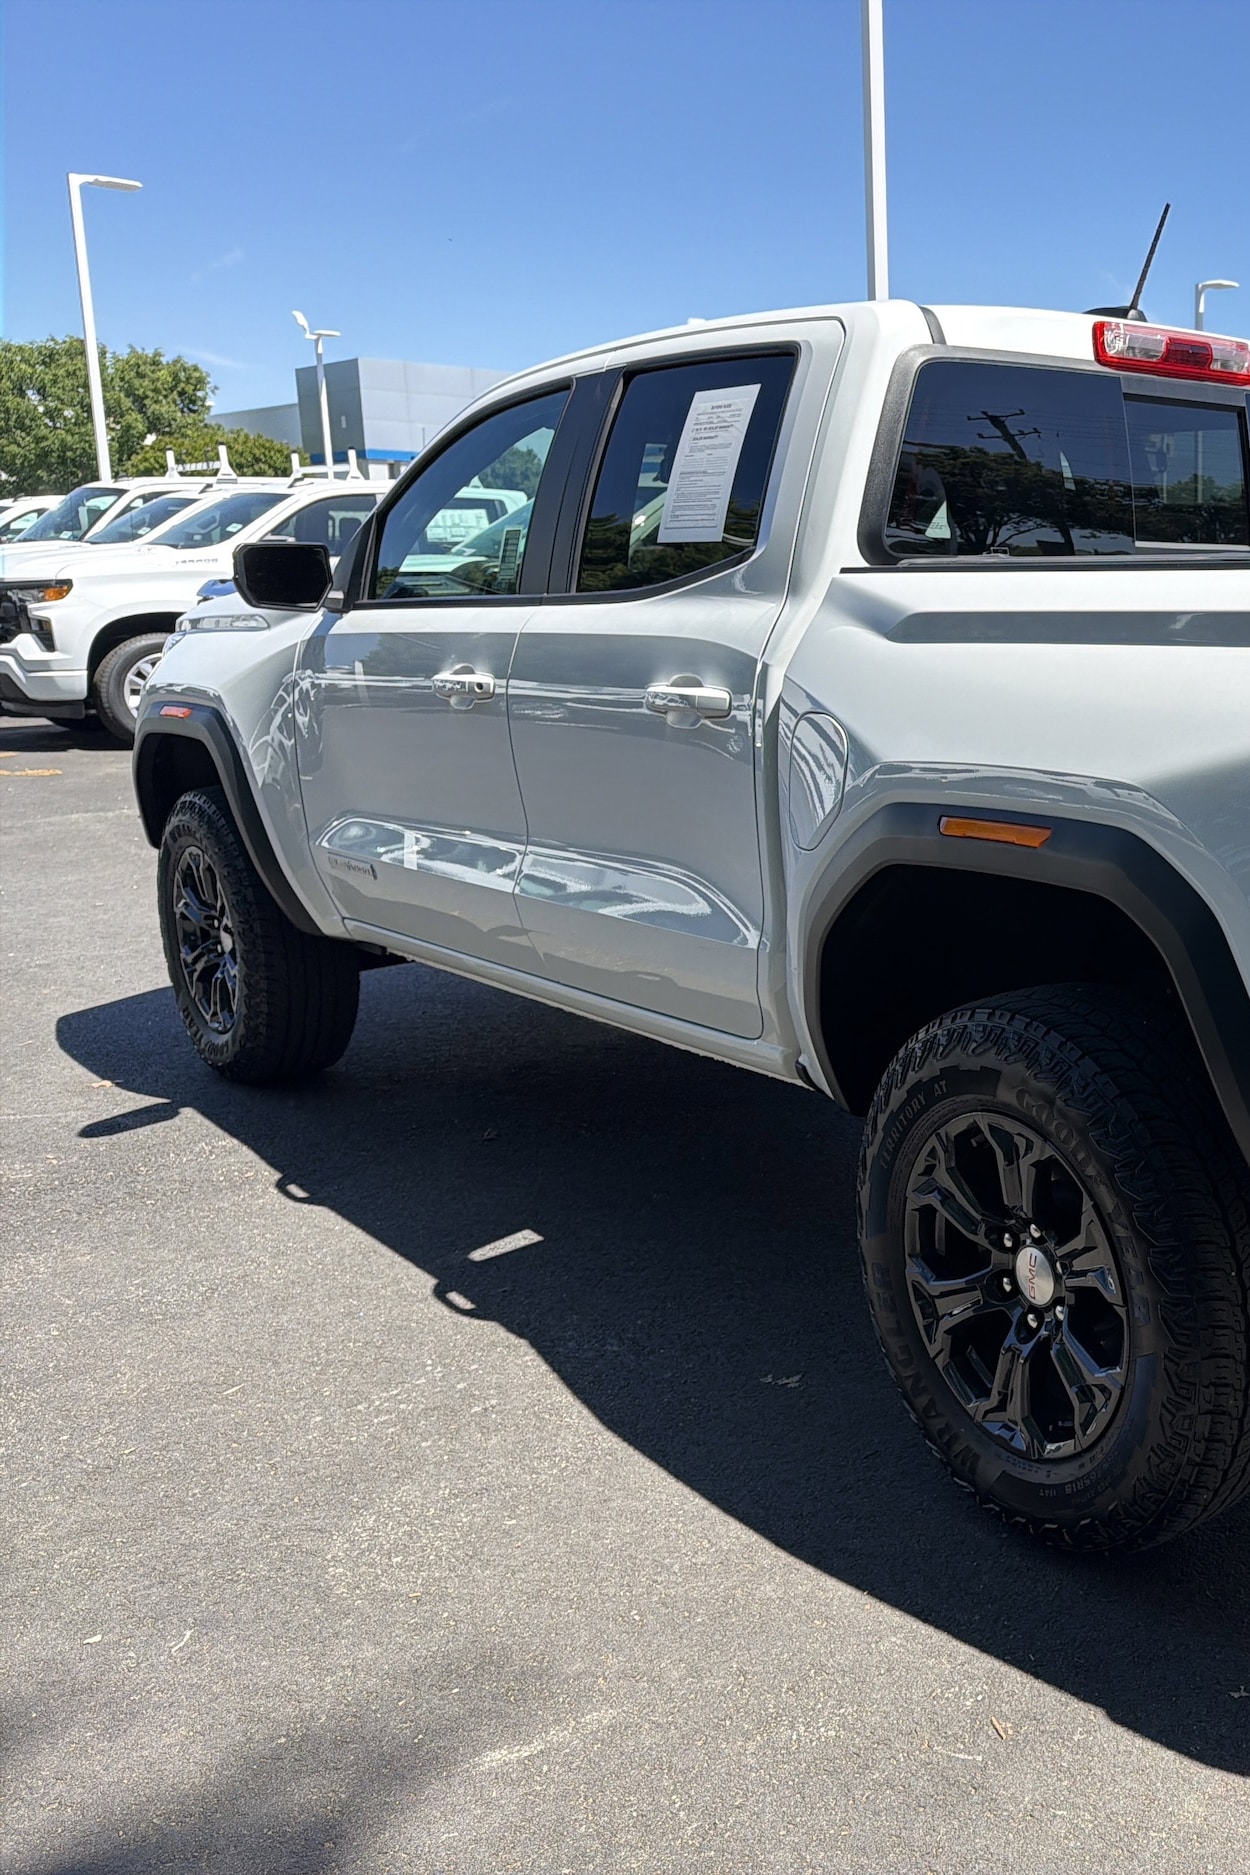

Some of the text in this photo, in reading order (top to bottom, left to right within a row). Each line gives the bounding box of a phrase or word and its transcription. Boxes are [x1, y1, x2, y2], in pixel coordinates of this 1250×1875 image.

[879, 1080, 948, 1170] TERRITORY AT
[1028, 1253, 1038, 1300] GMC
